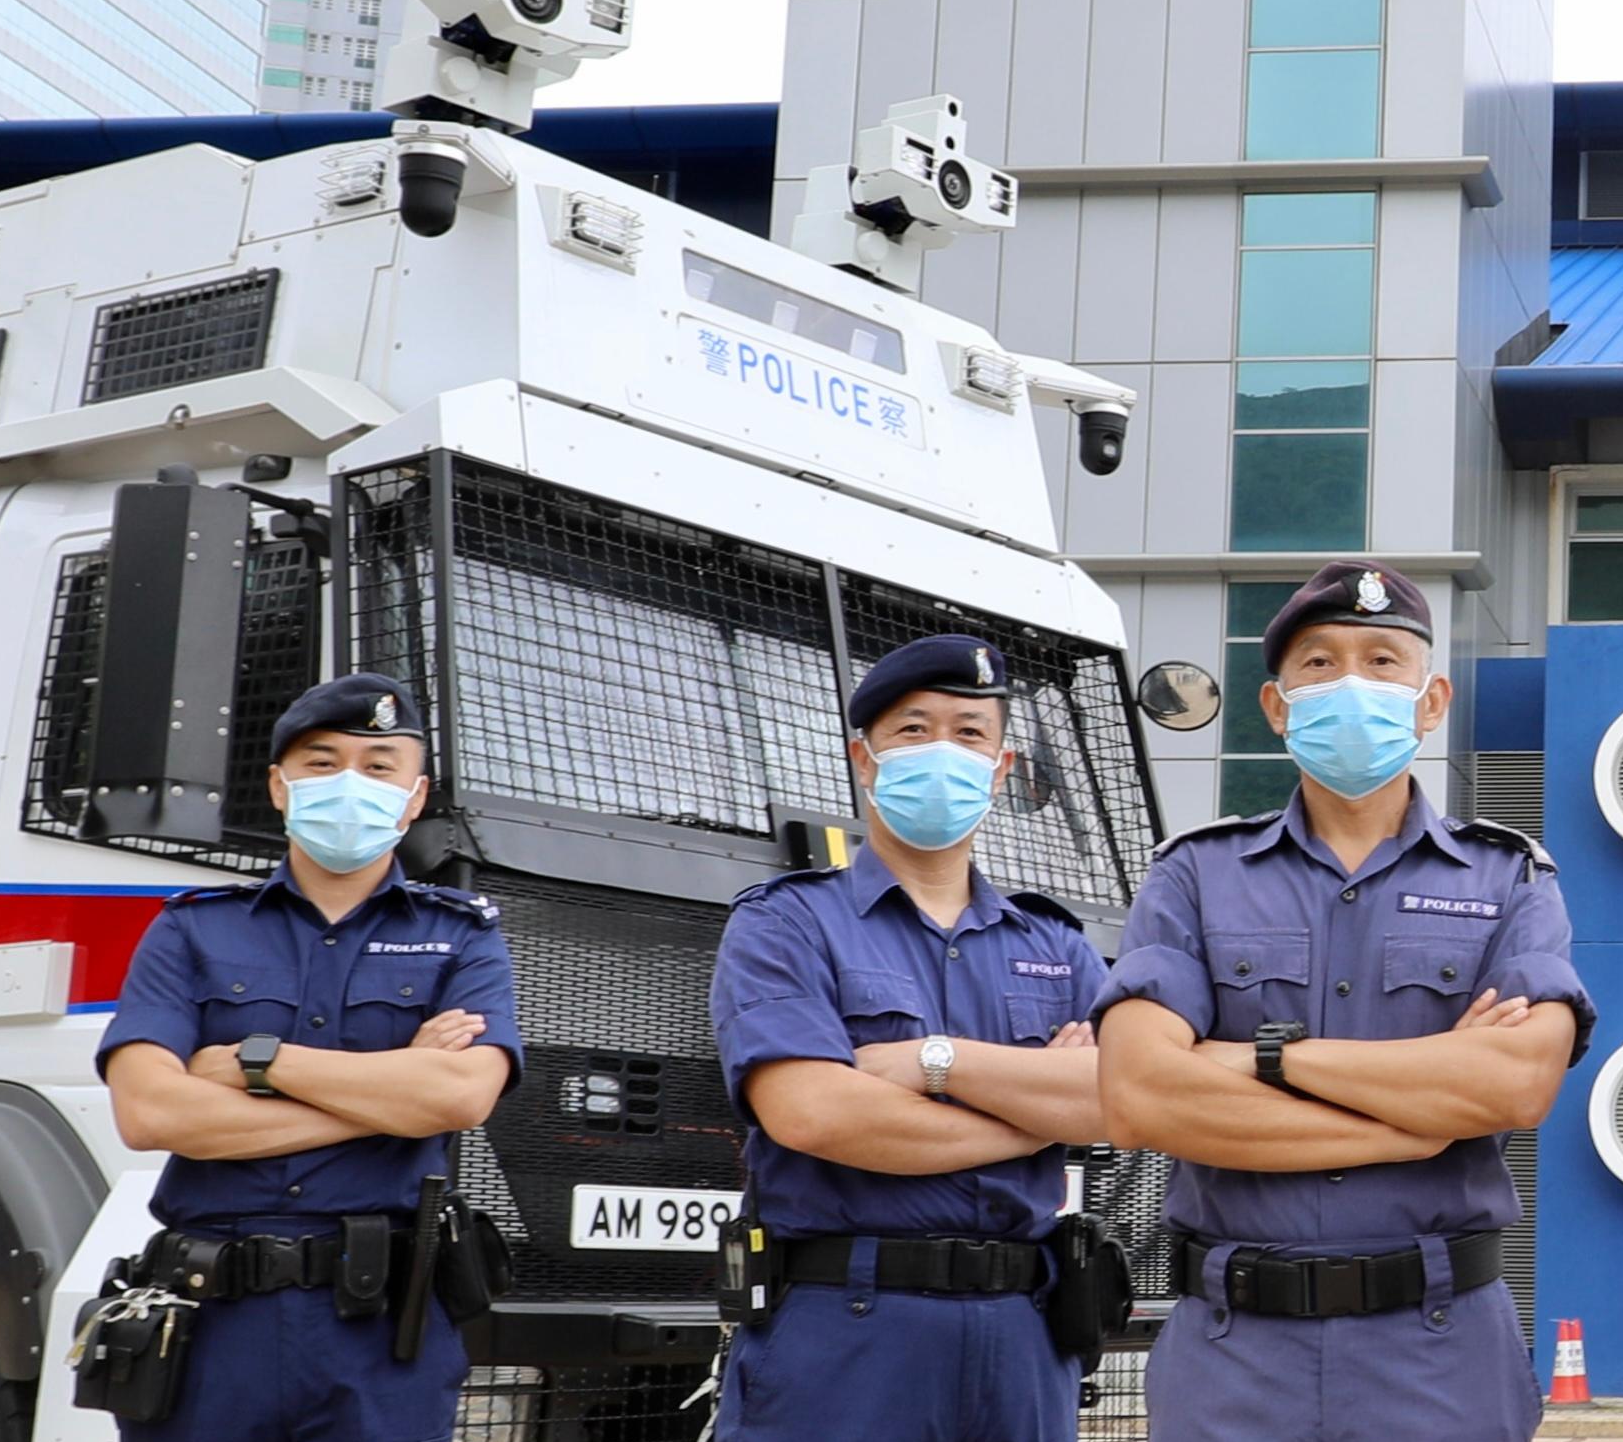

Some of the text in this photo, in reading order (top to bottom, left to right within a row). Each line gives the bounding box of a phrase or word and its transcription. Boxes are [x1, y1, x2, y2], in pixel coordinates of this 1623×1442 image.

[697, 328, 909, 438] 警 POLICE 察
[1422, 898, 1482, 913] POLICE
[383, 942, 436, 953] POLICE
[589, 1197, 642, 1238] AM
